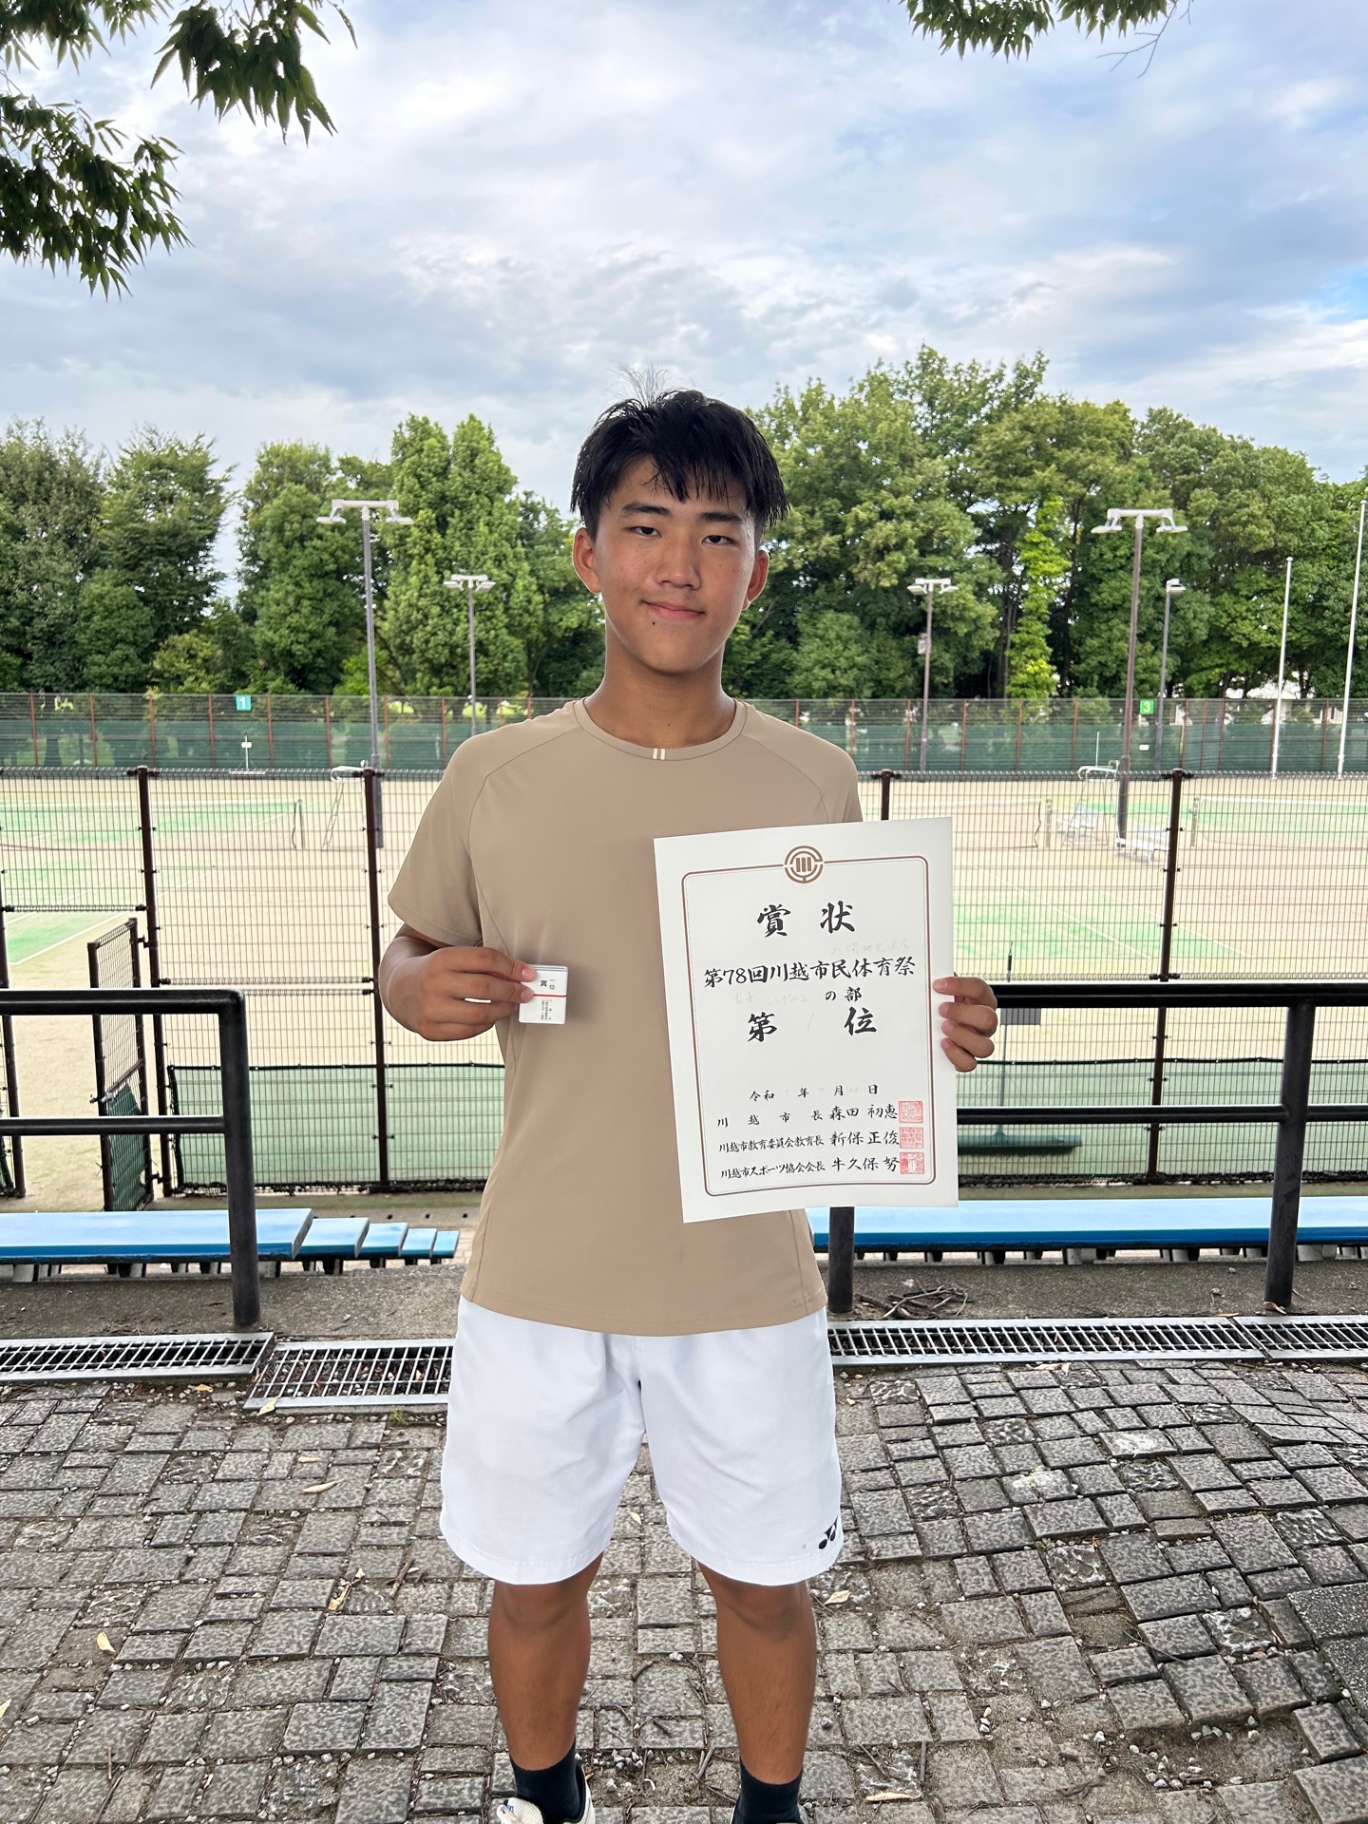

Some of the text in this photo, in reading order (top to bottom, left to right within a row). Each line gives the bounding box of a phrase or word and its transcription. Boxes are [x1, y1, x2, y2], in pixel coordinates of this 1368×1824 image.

[1143, 701, 1150, 713] 3
[704, 956, 916, 988] 第78回川越市民体育祭
